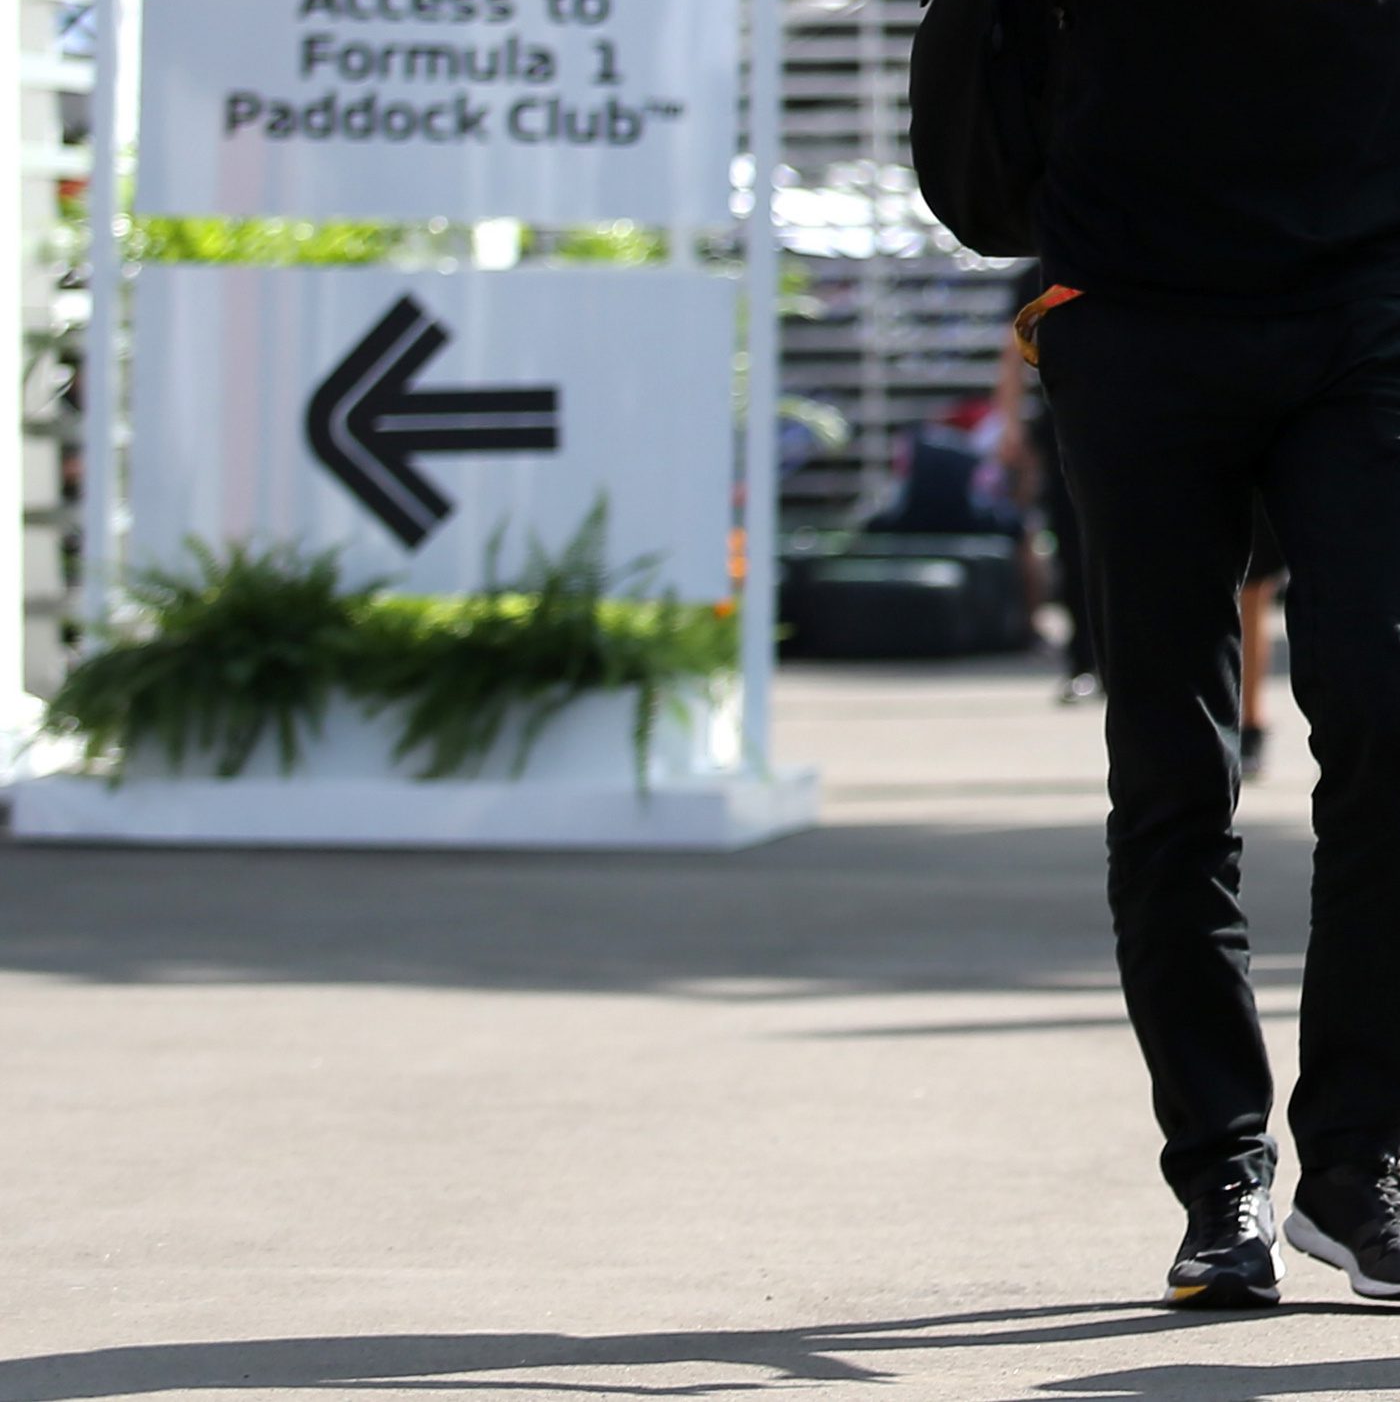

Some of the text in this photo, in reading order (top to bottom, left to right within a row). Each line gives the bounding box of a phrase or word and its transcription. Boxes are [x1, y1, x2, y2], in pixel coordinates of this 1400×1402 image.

[298, 34, 623, 85] Formula 1
[223, 92, 488, 144] Paddock
